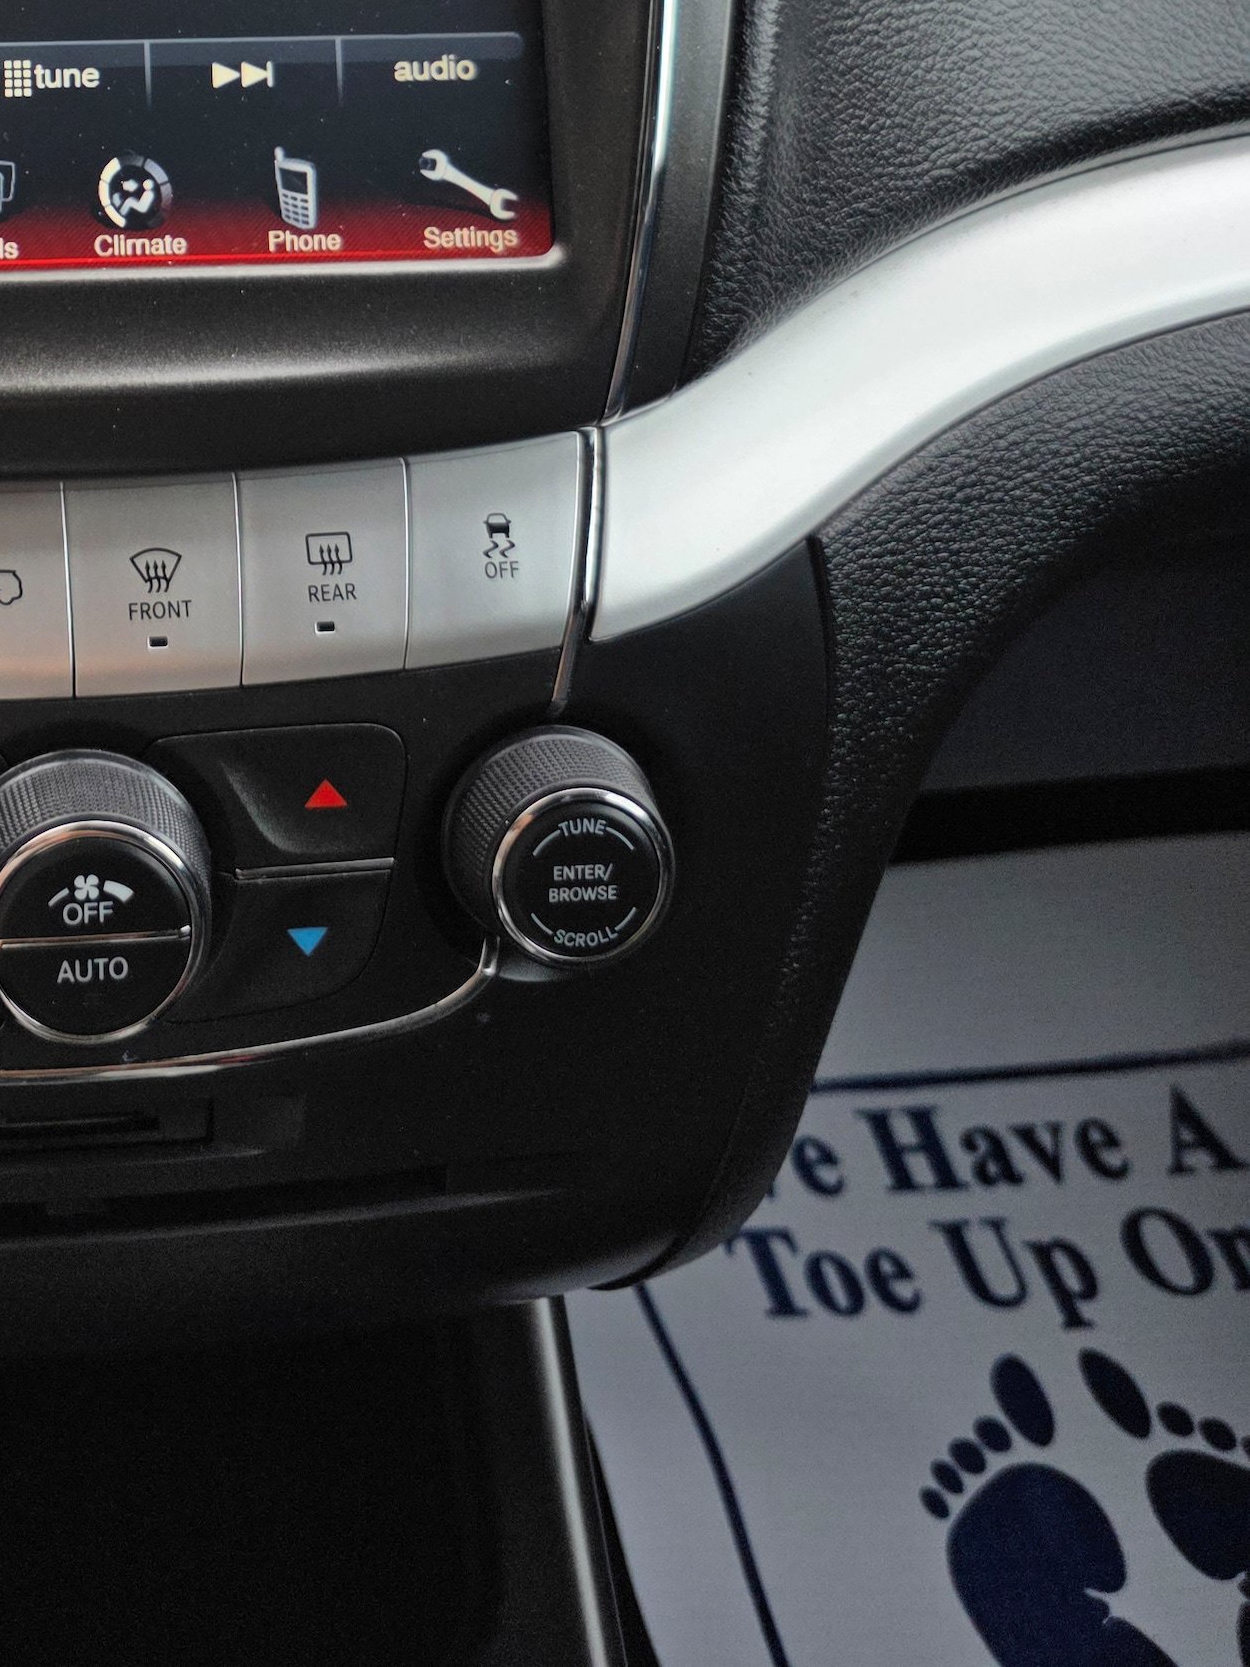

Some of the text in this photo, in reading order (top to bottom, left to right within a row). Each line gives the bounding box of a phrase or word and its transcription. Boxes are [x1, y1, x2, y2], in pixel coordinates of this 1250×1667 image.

[34, 64, 99, 88] tune
[394, 54, 476, 81] audio
[94, 235, 187, 256] Climate
[268, 229, 342, 253] Phone
[424, 226, 518, 253] Settings
[485, 561, 518, 579] OFF
[308, 583, 356, 602] REAR
[129, 600, 191, 620] FRONT
[559, 818, 607, 836] TUNE
[554, 864, 613, 881] ENTER/
[549, 885, 617, 902] BROWSE
[62, 901, 114, 926] OFF
[554, 926, 617, 947] SCROLL
[57, 957, 128, 983] AUTO
[854, 1104, 1131, 1194] Have
[1167, 1084, 1250, 1175] A
[726, 1226, 923, 1320] Toe
[928, 1217, 1098, 1330] Up
